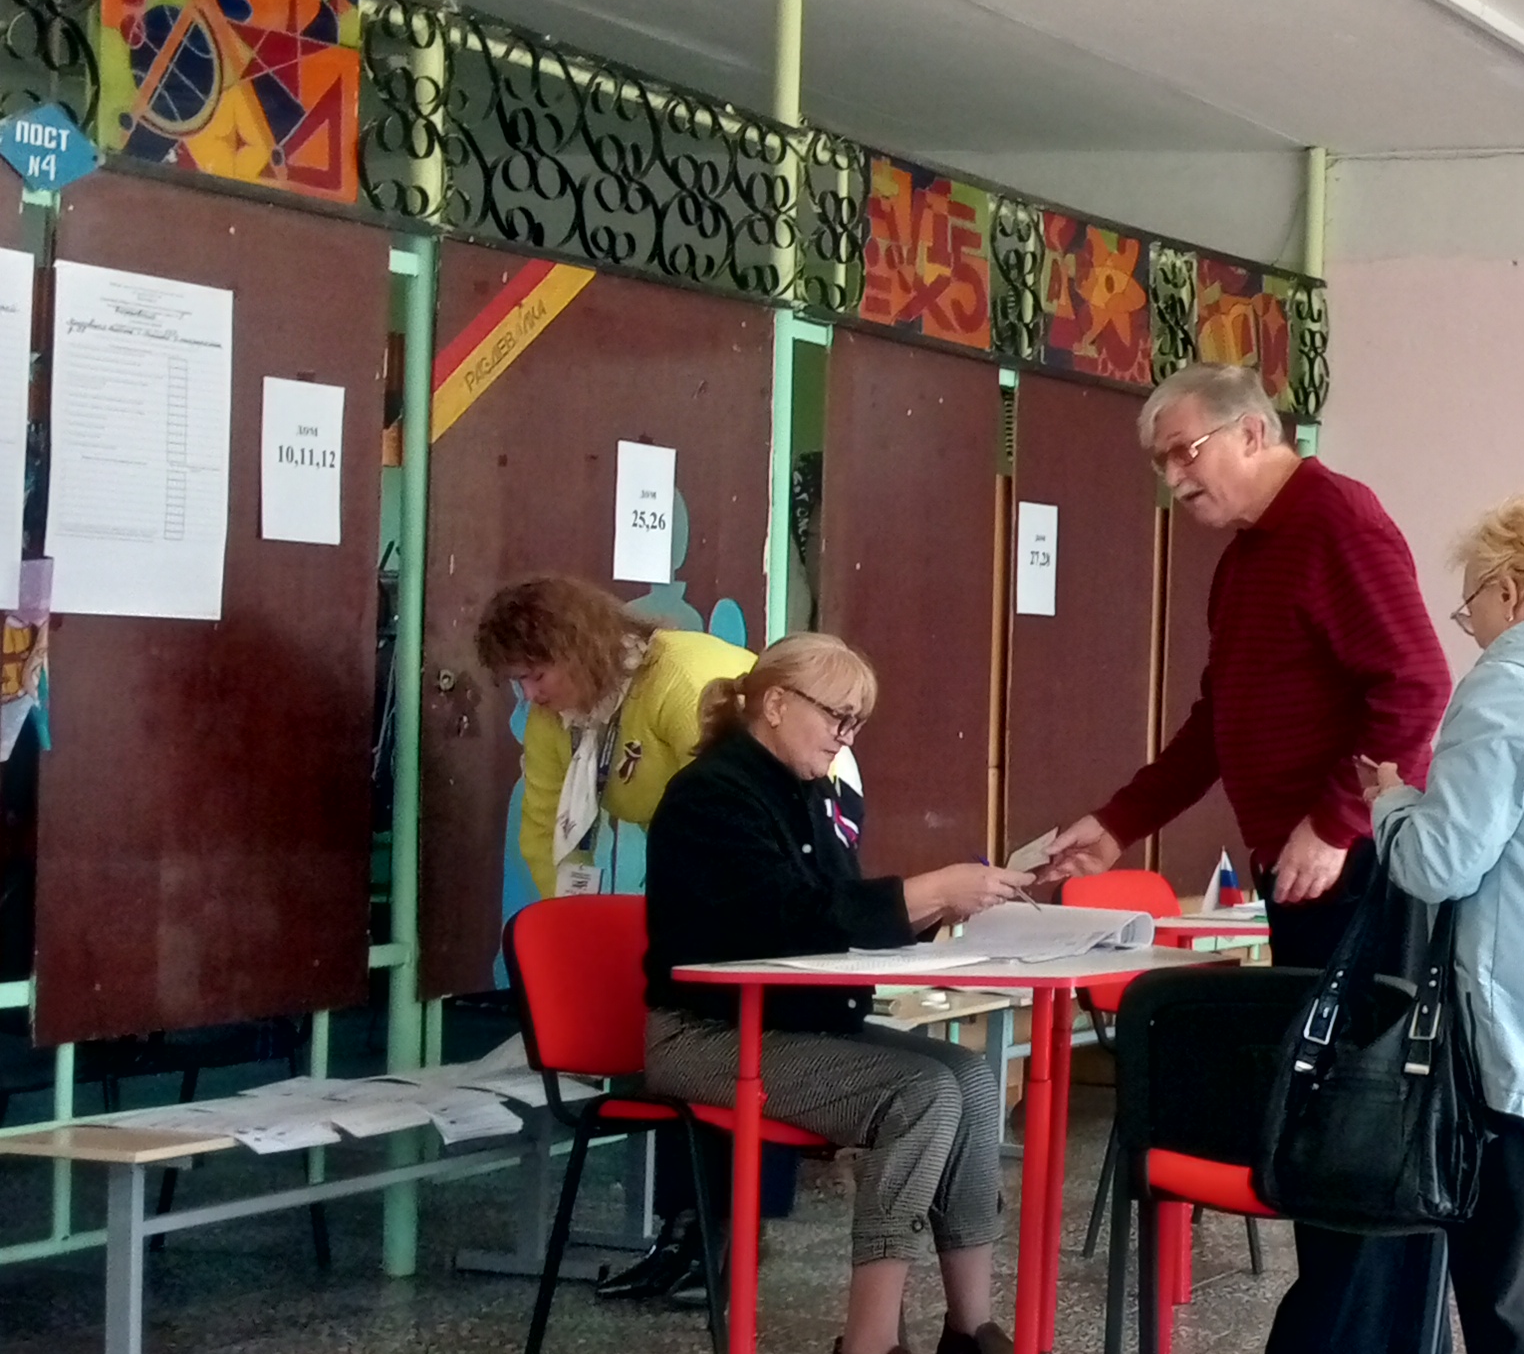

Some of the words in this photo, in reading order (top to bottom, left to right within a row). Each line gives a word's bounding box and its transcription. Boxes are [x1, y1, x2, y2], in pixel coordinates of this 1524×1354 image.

[15, 120, 71, 152] ПОСТ
[278, 445, 336, 469] 10,11,12
[632, 509, 666, 532] 25,26
